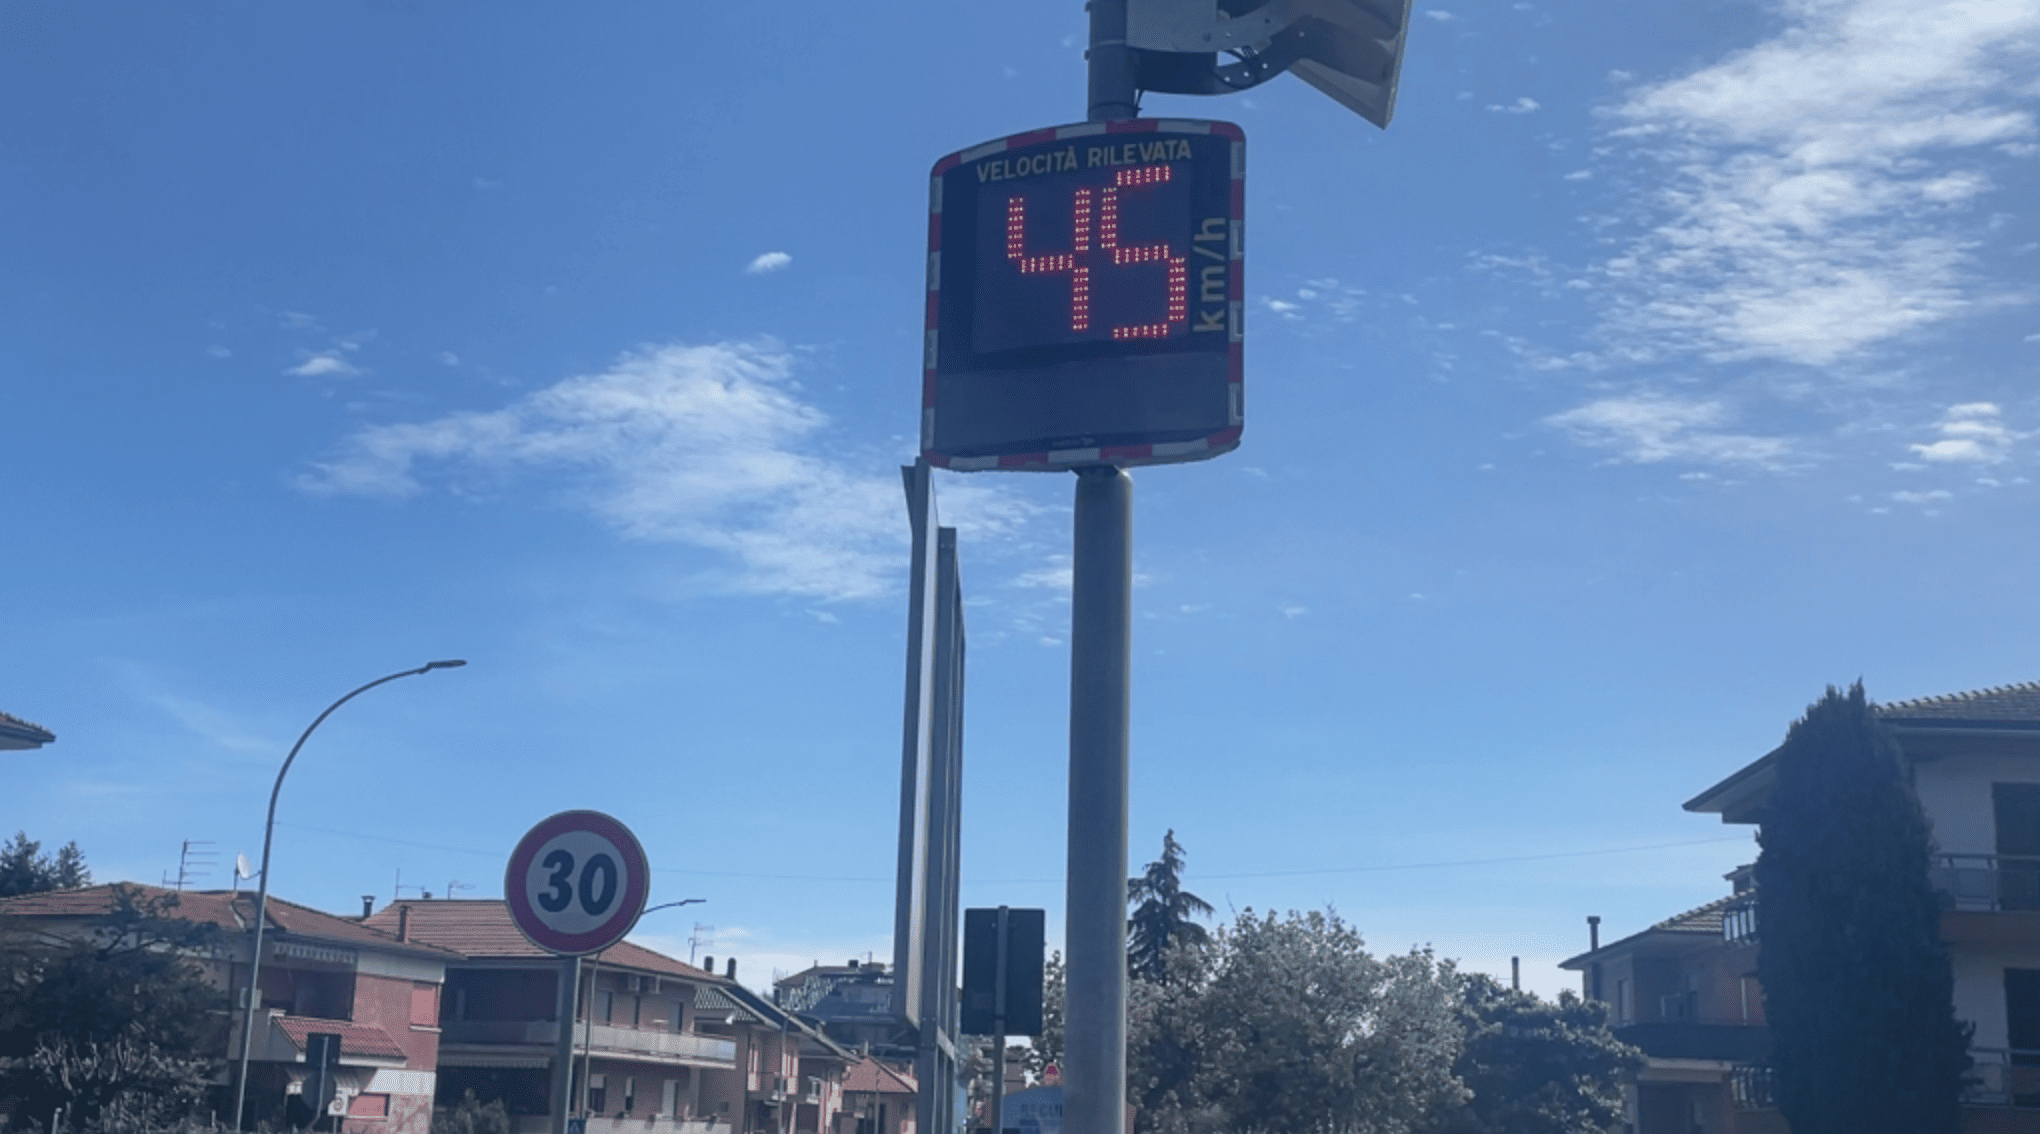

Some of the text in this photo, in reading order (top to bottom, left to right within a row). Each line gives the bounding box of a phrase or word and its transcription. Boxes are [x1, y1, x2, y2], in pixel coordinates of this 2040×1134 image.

[976, 139, 1192, 183] VELOCITÀ RILEVATA
[1007, 165, 1186, 339] 45
[1193, 217, 1226, 332] km/h
[537, 849, 618, 916] 30
